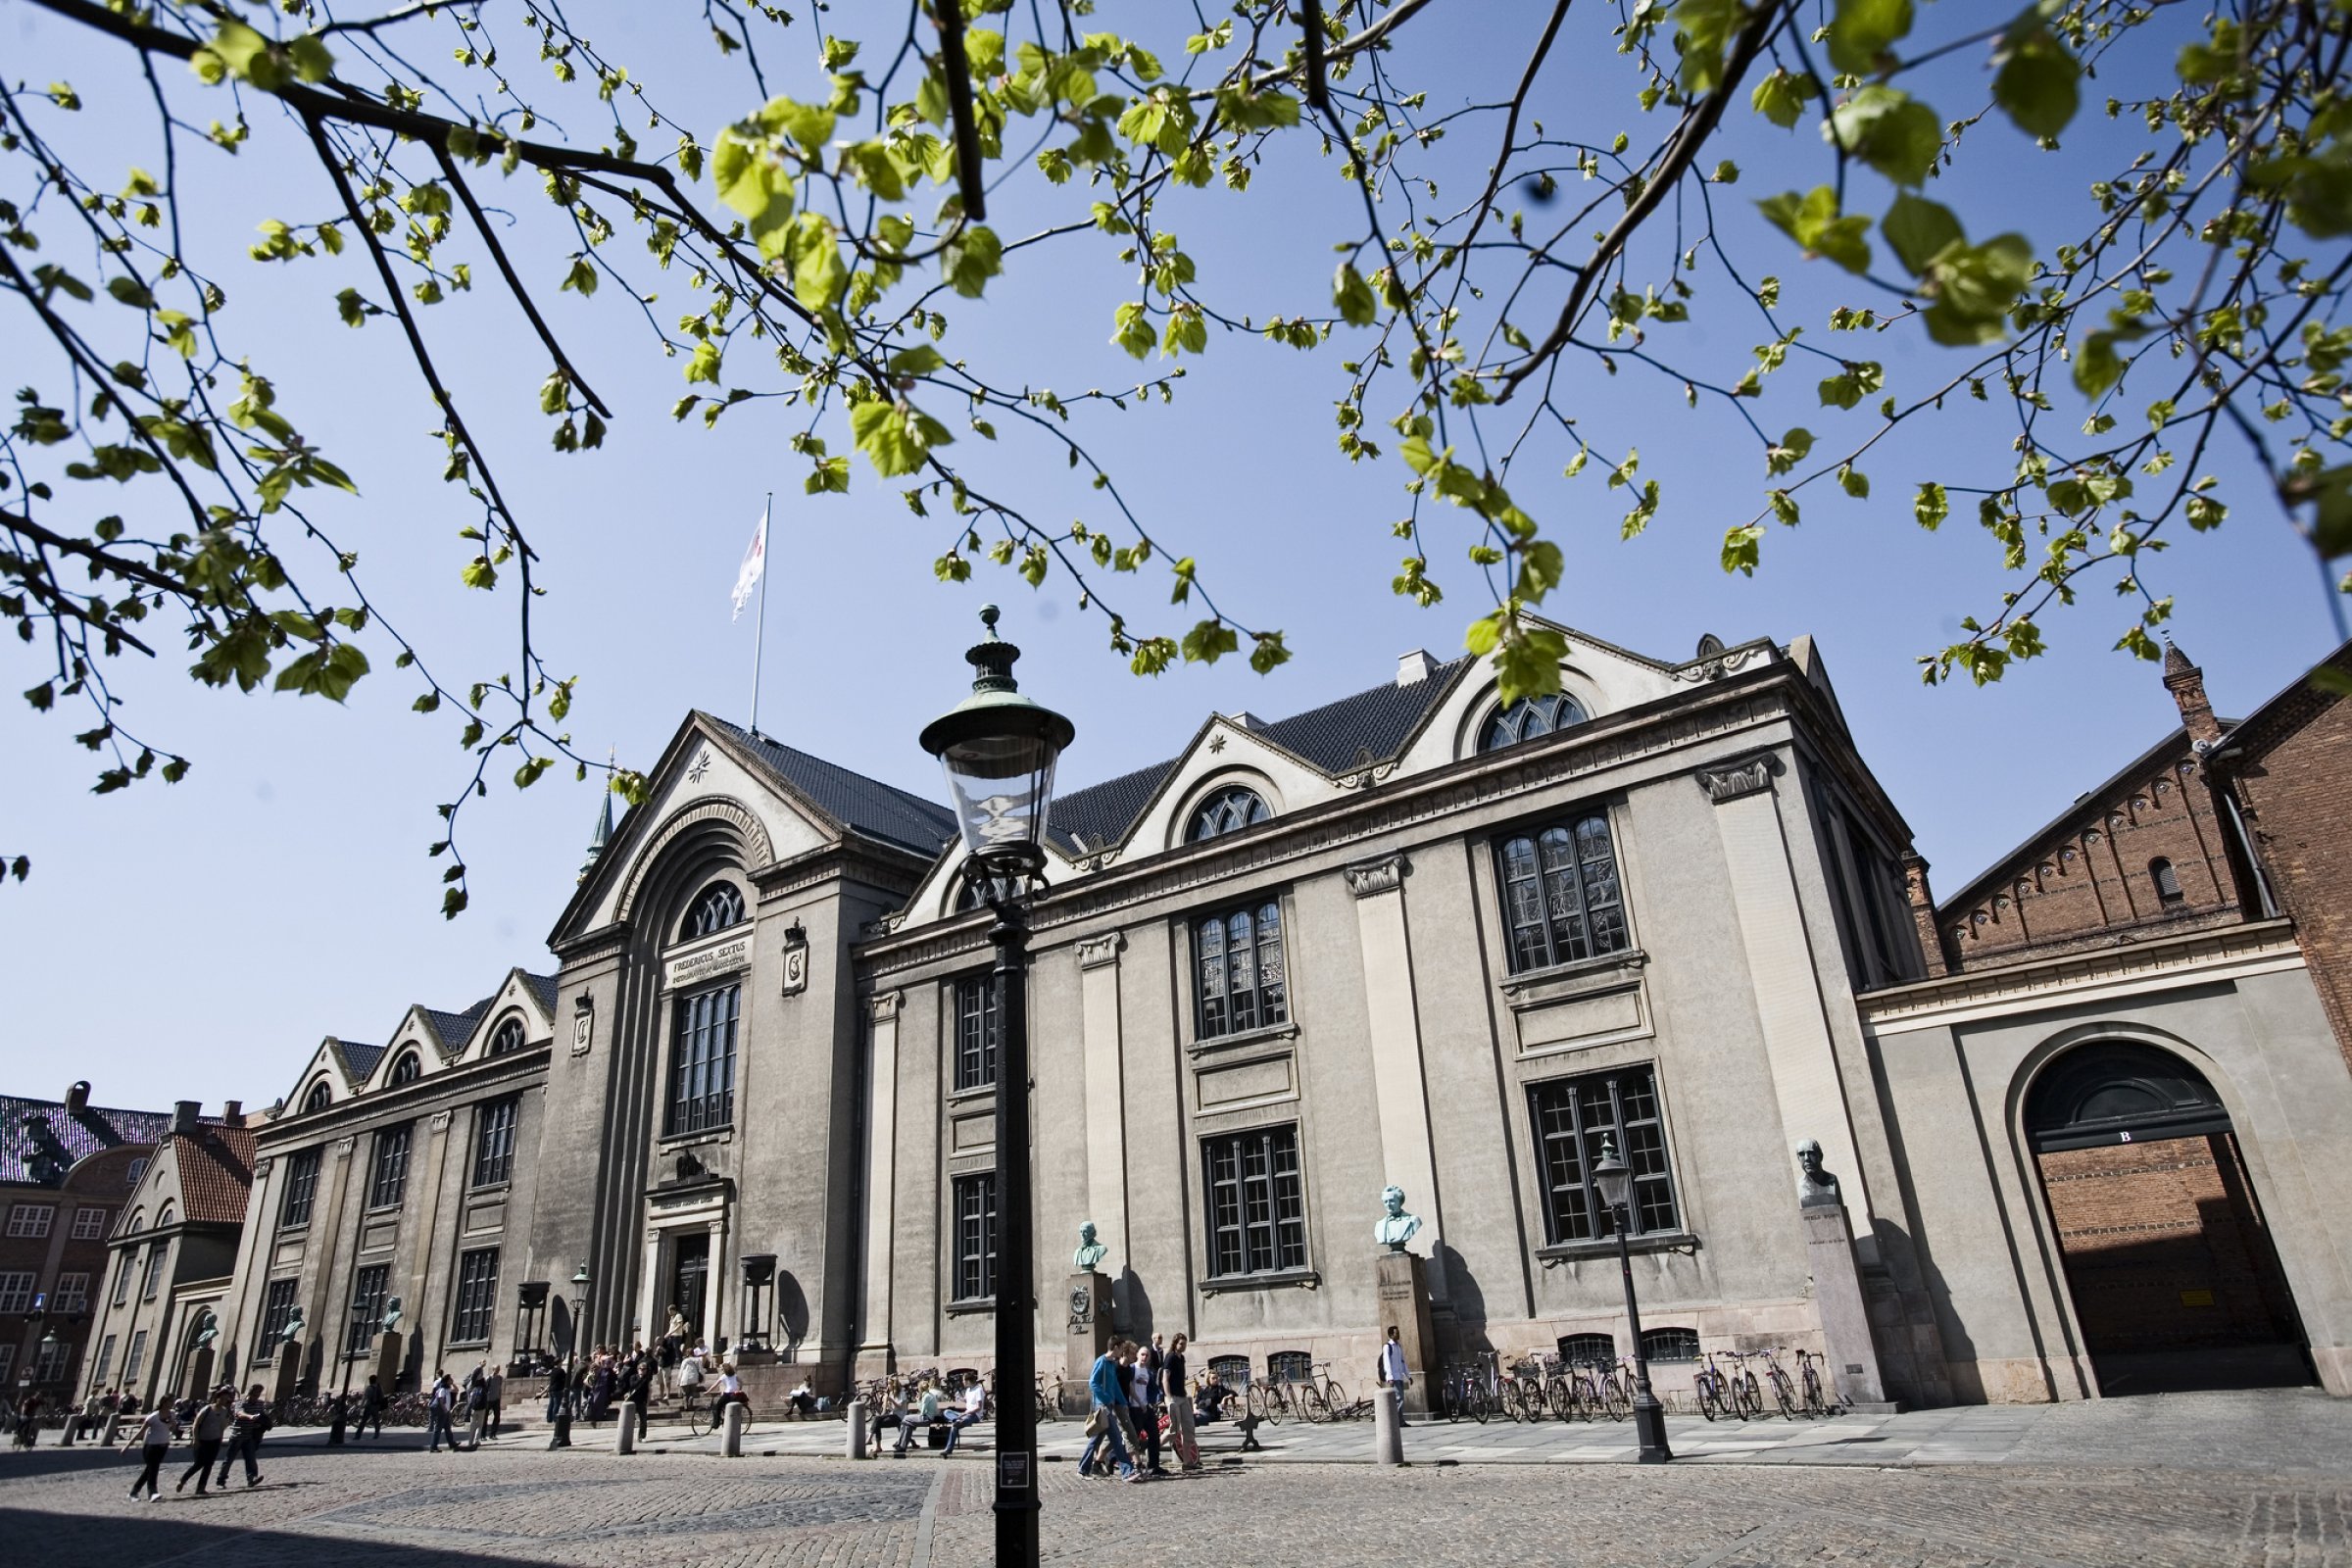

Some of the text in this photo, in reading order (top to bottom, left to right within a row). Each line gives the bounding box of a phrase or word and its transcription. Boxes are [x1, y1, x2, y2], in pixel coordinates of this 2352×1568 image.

[674, 952, 713, 972] FREDERICUS
[718, 942, 745, 958] SEXTUS
[2120, 1131, 2132, 1142] B
